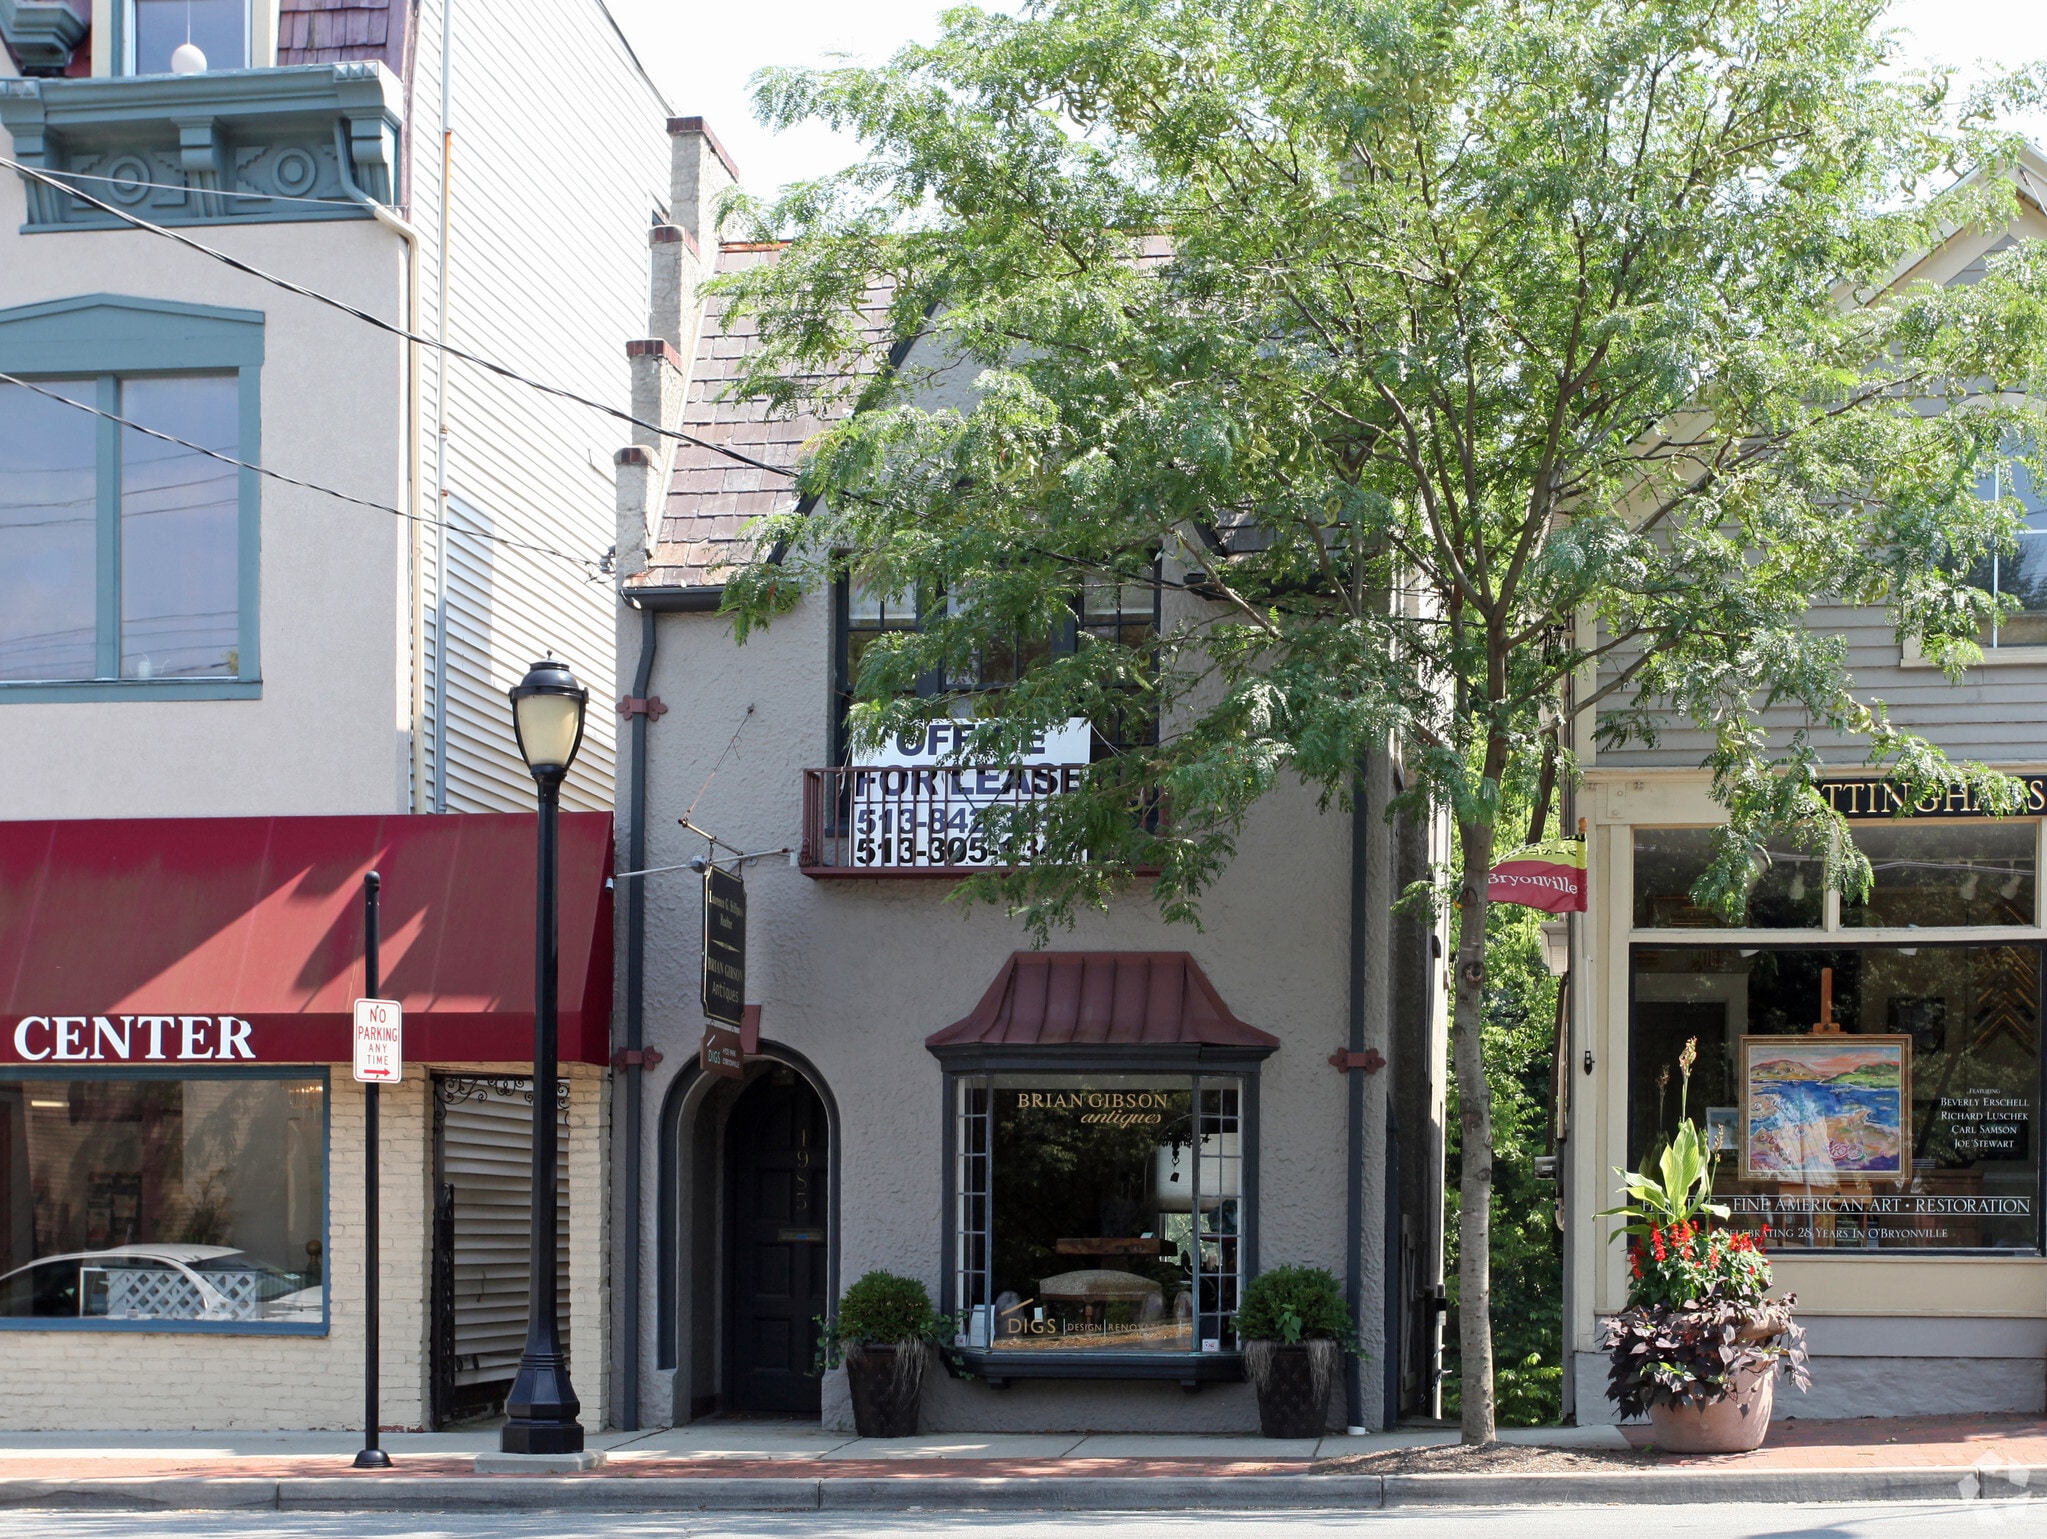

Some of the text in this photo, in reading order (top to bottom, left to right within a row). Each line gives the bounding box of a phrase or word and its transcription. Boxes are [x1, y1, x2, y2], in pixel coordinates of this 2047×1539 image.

[896, 724, 1045, 756] OFFE
[855, 764, 1086, 796] FOR LEASE
[370, 1008, 386, 1023] NO
[14, 1016, 255, 1060] CENTER
[358, 1026, 398, 1042] PARKING
[369, 1043, 388, 1054] ANY
[367, 1055, 389, 1066] TIME
[1018, 1093, 1168, 1108] BRIAN GIBSON
[1080, 1109, 1162, 1129] antiques
[1941, 1111, 1983, 1120] RICHARD
[1951, 1125, 2017, 1134] CARL SAMSON
[1954, 1138, 2014, 1149] JOE STEWART
[1734, 1199, 1770, 1213] FINE
[1775, 1199, 1864, 1213] AMERICAN
[1870, 1199, 1901, 1213] ART
[1916, 1199, 2030, 1213] RESTORATION
[1798, 1227, 1812, 1237] 28
[1816, 1228, 1848, 1239] YEARS
[1853, 1229, 1865, 1239] IN
[1008, 1319, 1178, 1334] DIGS DESIGN RENOVATI
